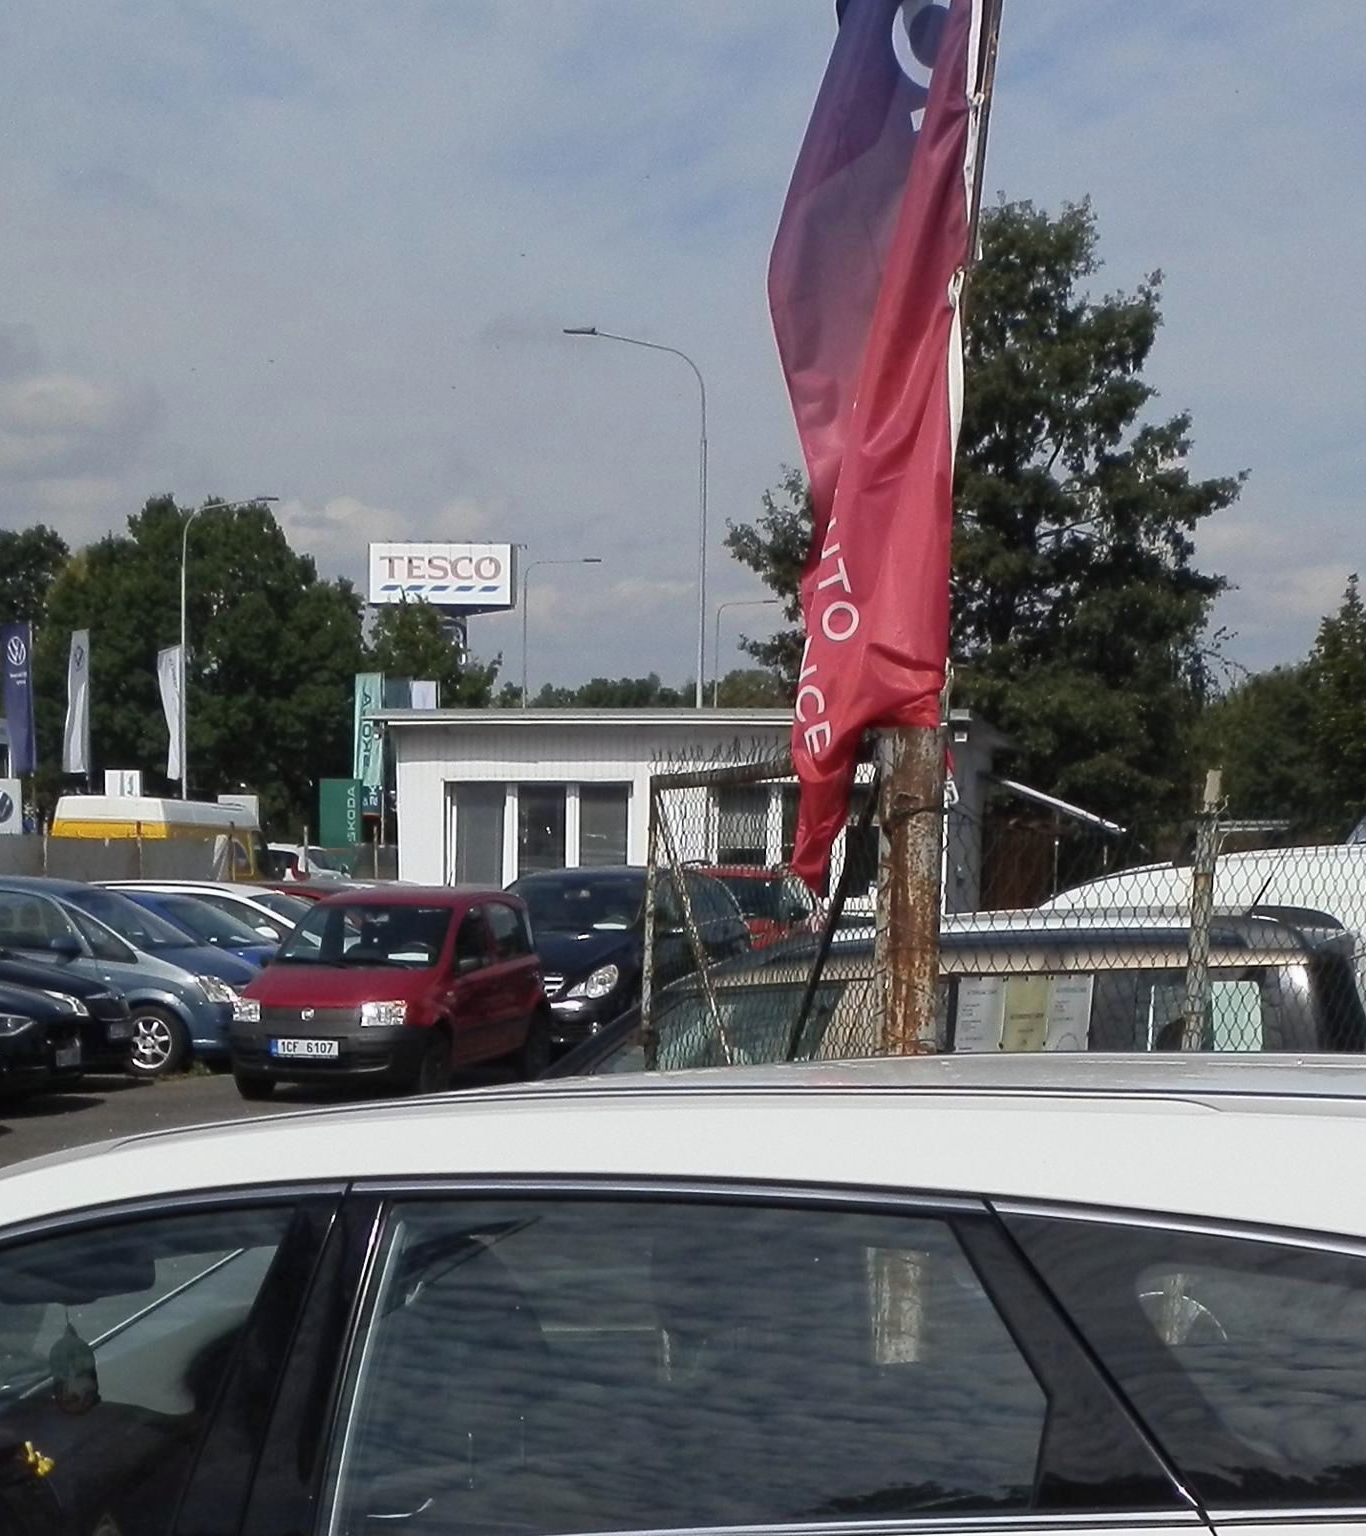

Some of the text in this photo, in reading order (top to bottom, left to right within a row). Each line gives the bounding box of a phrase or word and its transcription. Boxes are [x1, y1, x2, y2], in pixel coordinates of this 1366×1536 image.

[379, 555, 502, 580] TESCO
[281, 1041, 334, 1054] 1CF 6107
